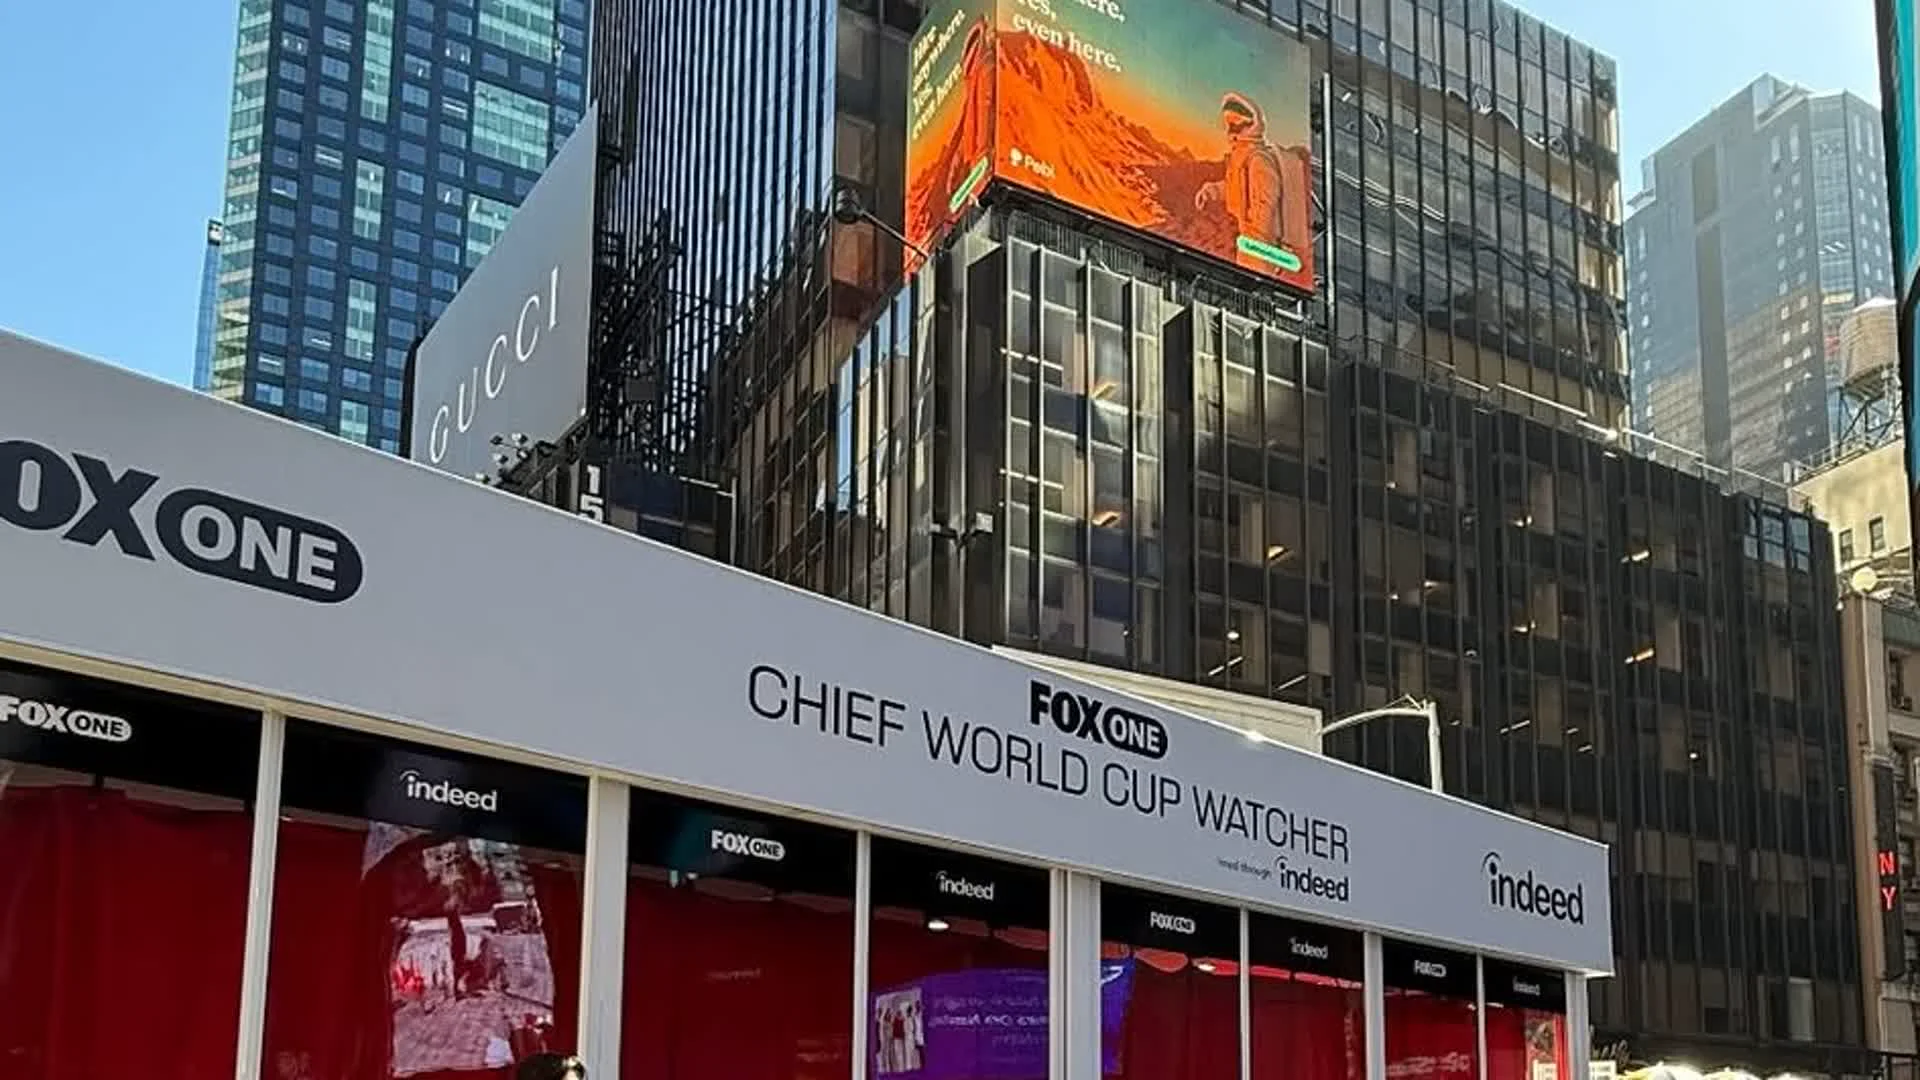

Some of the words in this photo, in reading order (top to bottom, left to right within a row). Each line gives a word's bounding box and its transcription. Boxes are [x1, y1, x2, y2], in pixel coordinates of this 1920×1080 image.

[1017, 0, 1057, 21] es,
[1066, 0, 1125, 23] ere.
[1012, 13, 1065, 49] even
[1067, 31, 1122, 72] here.
[429, 264, 560, 464] GUCCI
[0, 439, 160, 561] OX
[178, 503, 340, 593] ONE
[0, 694, 70, 733] FOX
[71, 712, 127, 740] ONE
[1029, 679, 1103, 744] FOX
[1108, 711, 1163, 754] ONE
[748, 664, 907, 748] CHIEF
[921, 708, 1089, 797] WORLD
[1102, 762, 1182, 818] CUP
[1192, 784, 1350, 864] WATCHER
[399, 769, 498, 813] indeed
[710, 828, 751, 857] FOX
[936, 869, 995, 902] indeed
[1275, 855, 1350, 903] indeed
[1481, 851, 1585, 926] indeed
